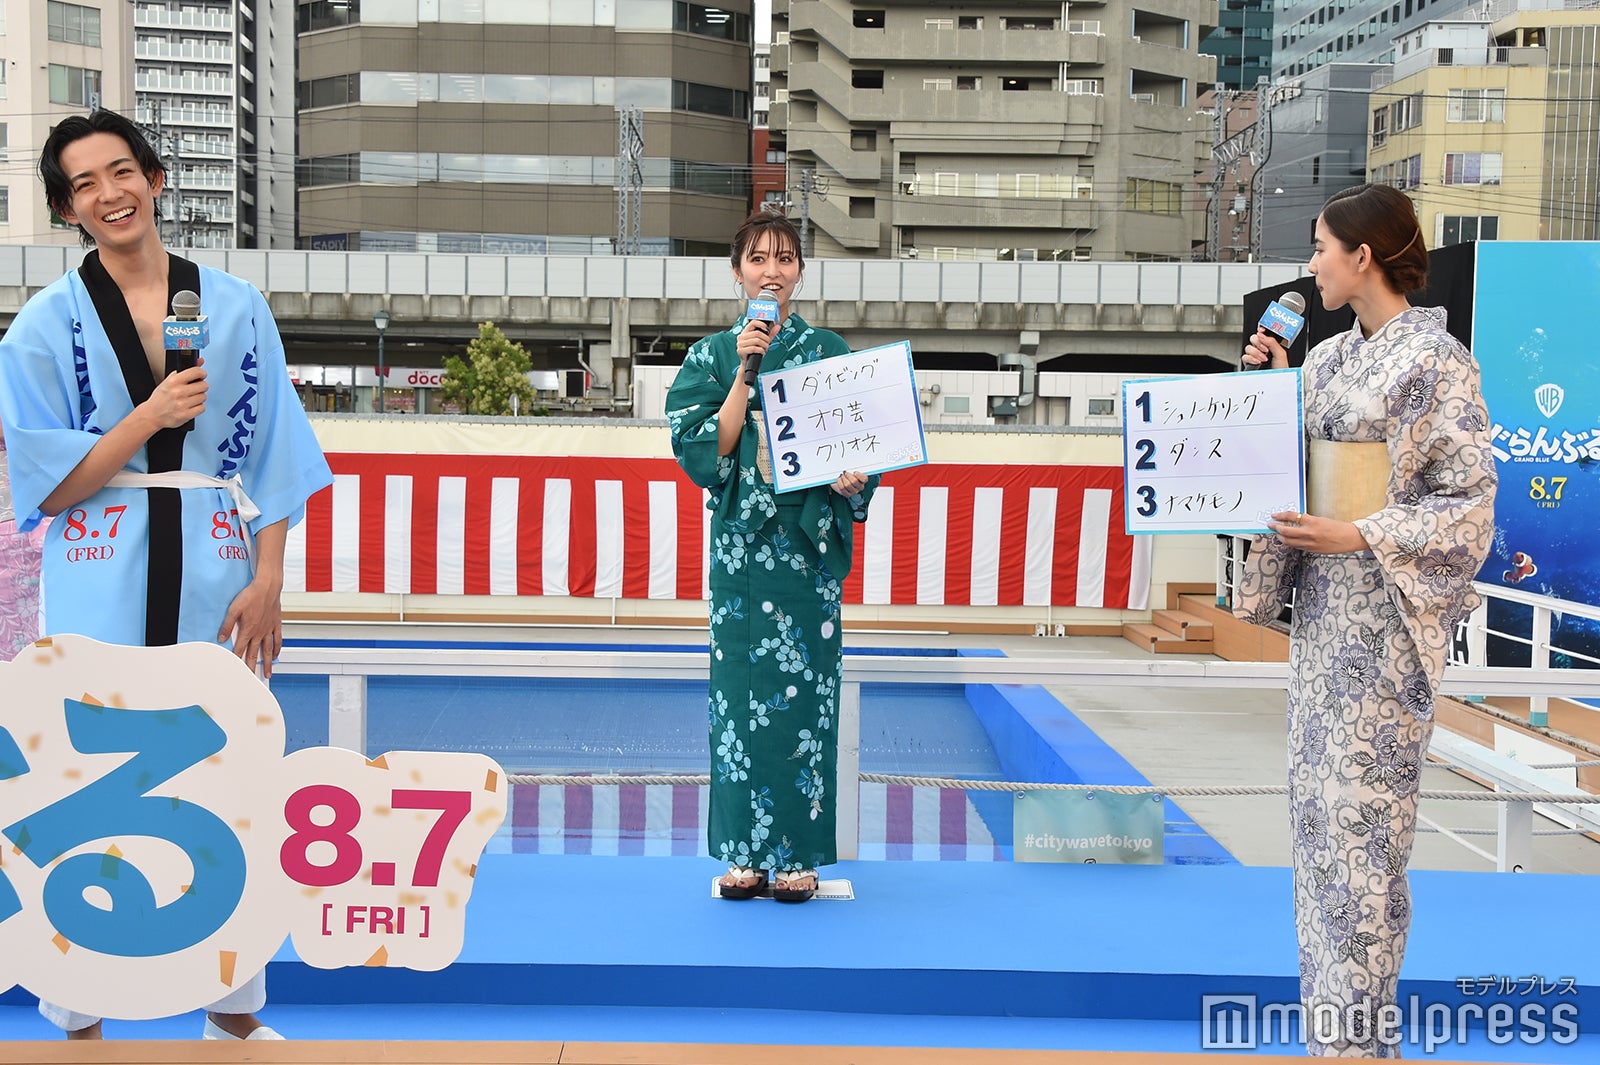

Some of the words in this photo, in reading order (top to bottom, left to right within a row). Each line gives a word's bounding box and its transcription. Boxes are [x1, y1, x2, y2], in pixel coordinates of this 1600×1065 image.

[486, 241, 541, 255] SAPIX
[771, 379, 787, 404] 1
[801, 358, 879, 397] ダイビング
[775, 416, 797, 442] 2
[808, 401, 865, 431] オタ芸
[1135, 391, 1151, 423] 1
[1163, 391, 1264, 424] シュノーケリング
[781, 451, 801, 477] 3
[816, 433, 881, 463] クリオネ
[1135, 439, 1157, 471] 2
[1170, 437, 1223, 466] ダンス
[1491, 423, 1600, 464] ぐらんぶる
[1136, 485, 1158, 517] 3
[1165, 491, 1243, 515] ナマケモノ
[1529, 476, 1568, 500] 8.7
[64, 505, 128, 542] 8.7
[66, 545, 115, 564] (FRI)
[279, 784, 473, 888] 8.7
[1024, 833, 1153, 852] #citywavetokyo
